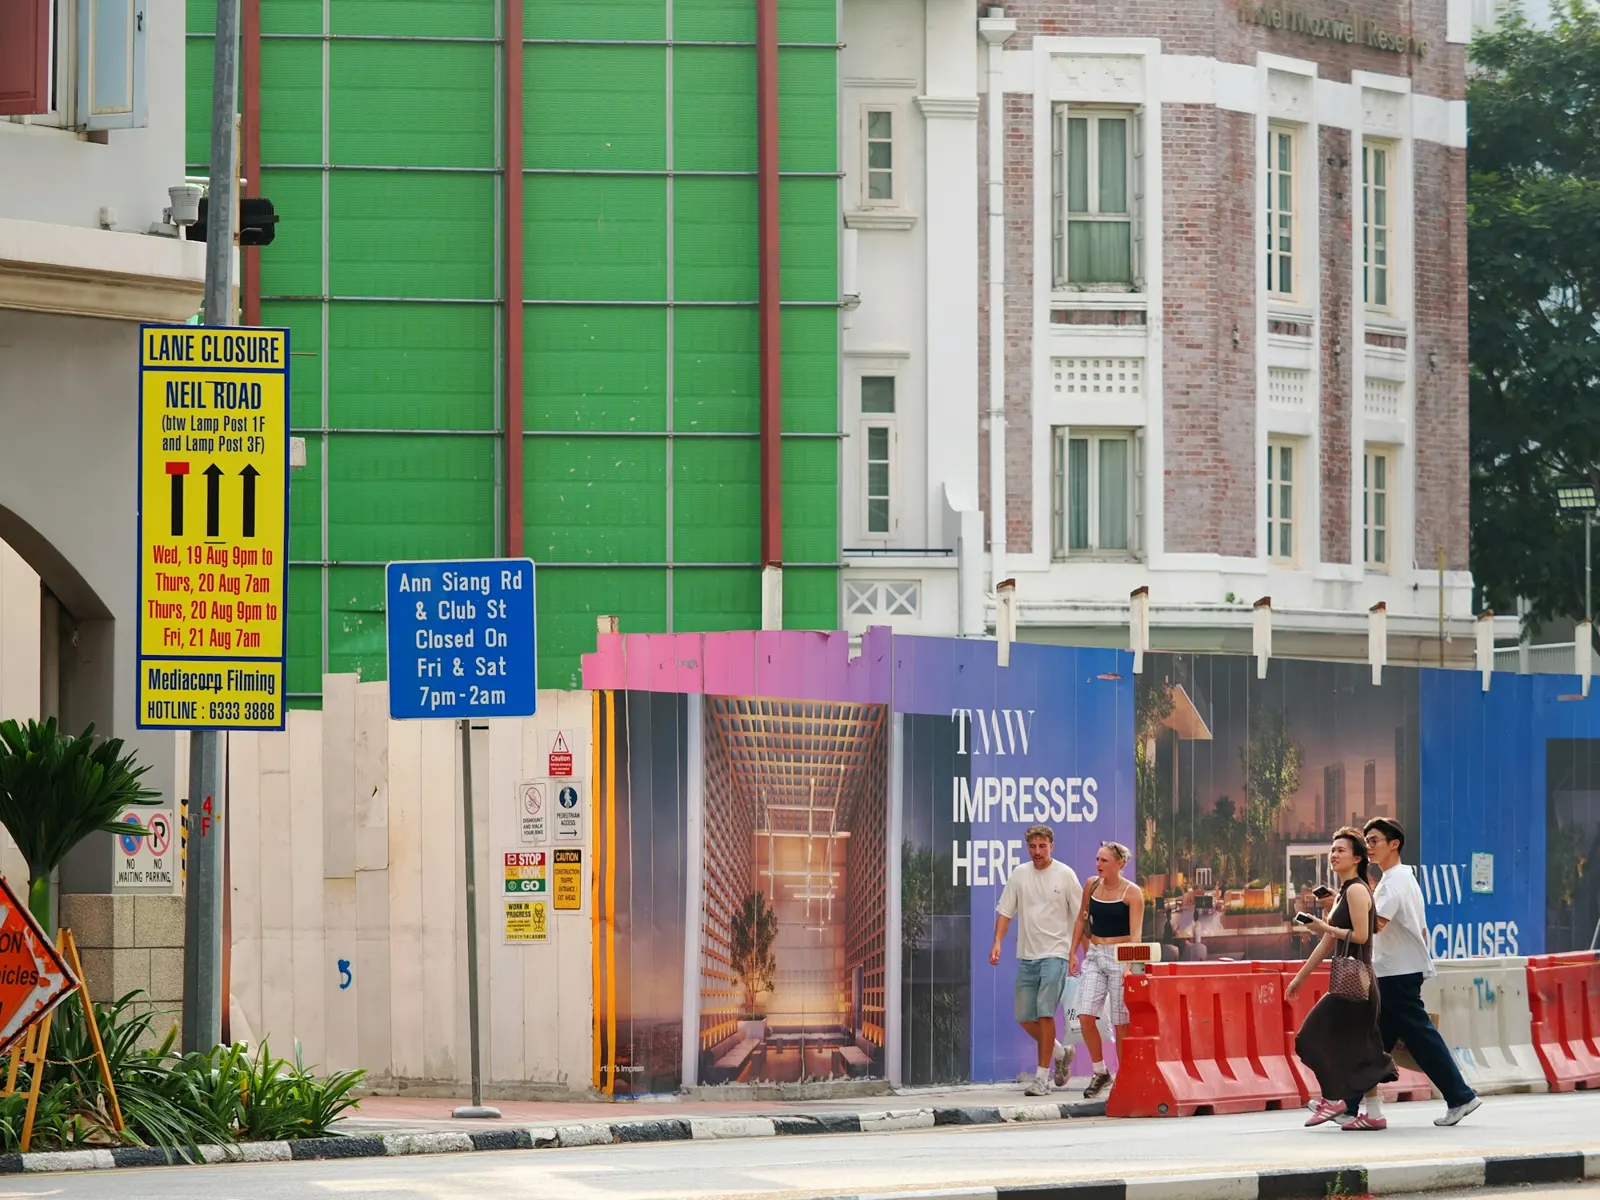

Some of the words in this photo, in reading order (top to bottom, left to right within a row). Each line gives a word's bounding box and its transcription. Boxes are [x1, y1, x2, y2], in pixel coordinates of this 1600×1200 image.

[1368, 20, 1429, 56] Reserve
[149, 335, 195, 361] LANE
[201, 335, 279, 363] CLOSURE
[166, 381, 206, 409] NEIL
[214, 382, 262, 410] ROAD
[162, 414, 186, 433] (btw
[191, 415, 219, 434] Lamp
[223, 416, 247, 432] Post
[253, 416, 265, 432] 1F
[162, 435, 181, 451] and
[186, 436, 214, 454] Lamp
[218, 436, 243, 452] Post
[247, 436, 265, 454] 3F)
[153, 545, 181, 567] Wed,
[187, 545, 202, 564] 19
[206, 546, 228, 568] Aug
[232, 546, 257, 568] 9pm
[262, 548, 273, 565] to
[155, 573, 194, 595] Thurs,
[198, 573, 214, 592] 20
[218, 573, 240, 595] Aug
[245, 574, 269, 593] 7am
[399, 573, 432, 593] Ann
[442, 571, 491, 596] Siang
[501, 570, 522, 590] Rd
[148, 600, 186, 622] Thurs,
[191, 600, 207, 619] 20
[211, 601, 232, 623] Aug
[237, 601, 262, 623] 9pm
[266, 602, 277, 621] to
[415, 601, 427, 620] &
[438, 600, 476, 620] Club
[487, 598, 507, 619] St
[163, 628, 184, 649] Fri,
[189, 628, 203, 647] 21
[209, 628, 231, 650] Aug
[235, 629, 260, 648] 7am
[415, 628, 474, 649] Closed
[485, 627, 508, 648] On
[417, 658, 442, 677] Fri
[452, 657, 465, 676] &
[475, 656, 507, 676] Sat
[148, 668, 222, 694] Mediacorp
[227, 670, 275, 695] Filming
[148, 701, 197, 719] HOTLINE
[209, 701, 240, 720] 6333
[244, 702, 275, 720] 3888
[951, 708, 1035, 755] TMW
[953, 777, 1098, 823] IMPRESSES
[126, 858, 136, 870] NO
[153, 858, 163, 870] NO
[518, 853, 541, 865] STOP
[555, 853, 579, 862] CAUTION
[952, 840, 1022, 887] HERE
[118, 871, 143, 883] WAITING
[145, 871, 170, 883] PARKING
[519, 866, 541, 878] LOOK
[521, 880, 540, 891] GO
[1413, 864, 1467, 905] MW
[1425, 921, 1519, 960] CIALISES
